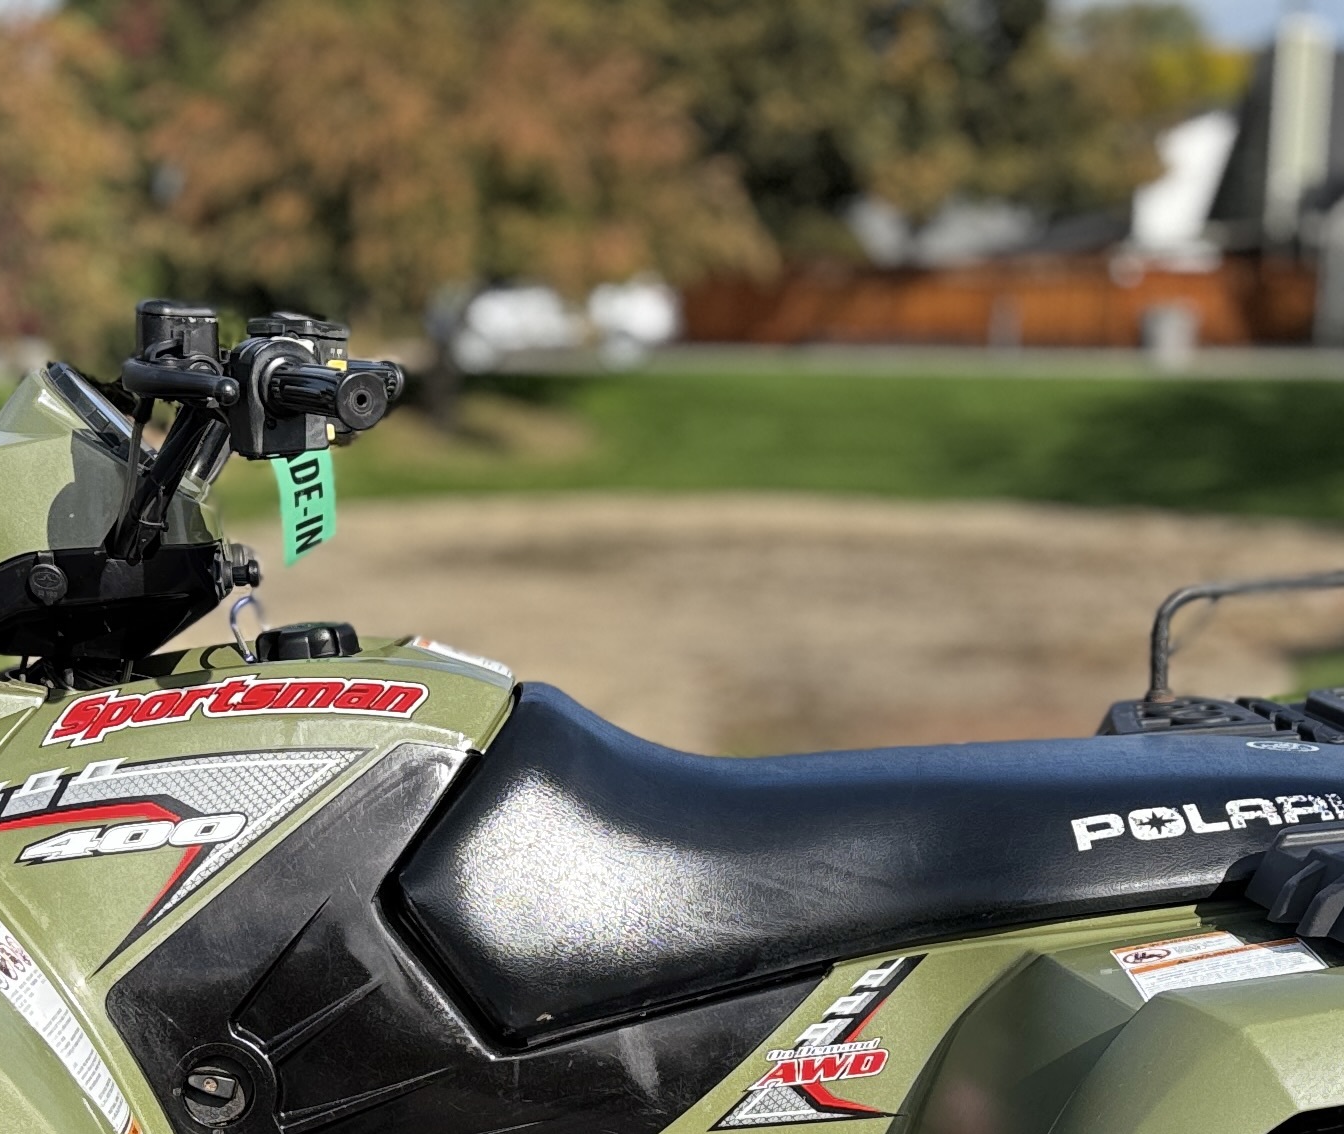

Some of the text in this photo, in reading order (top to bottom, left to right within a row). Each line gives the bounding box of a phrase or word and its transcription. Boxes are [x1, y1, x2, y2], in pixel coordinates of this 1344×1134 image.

[44, 676, 428, 746] Sportsman
[19, 813, 249, 862] 400
[747, 1049, 889, 1090] AWD
